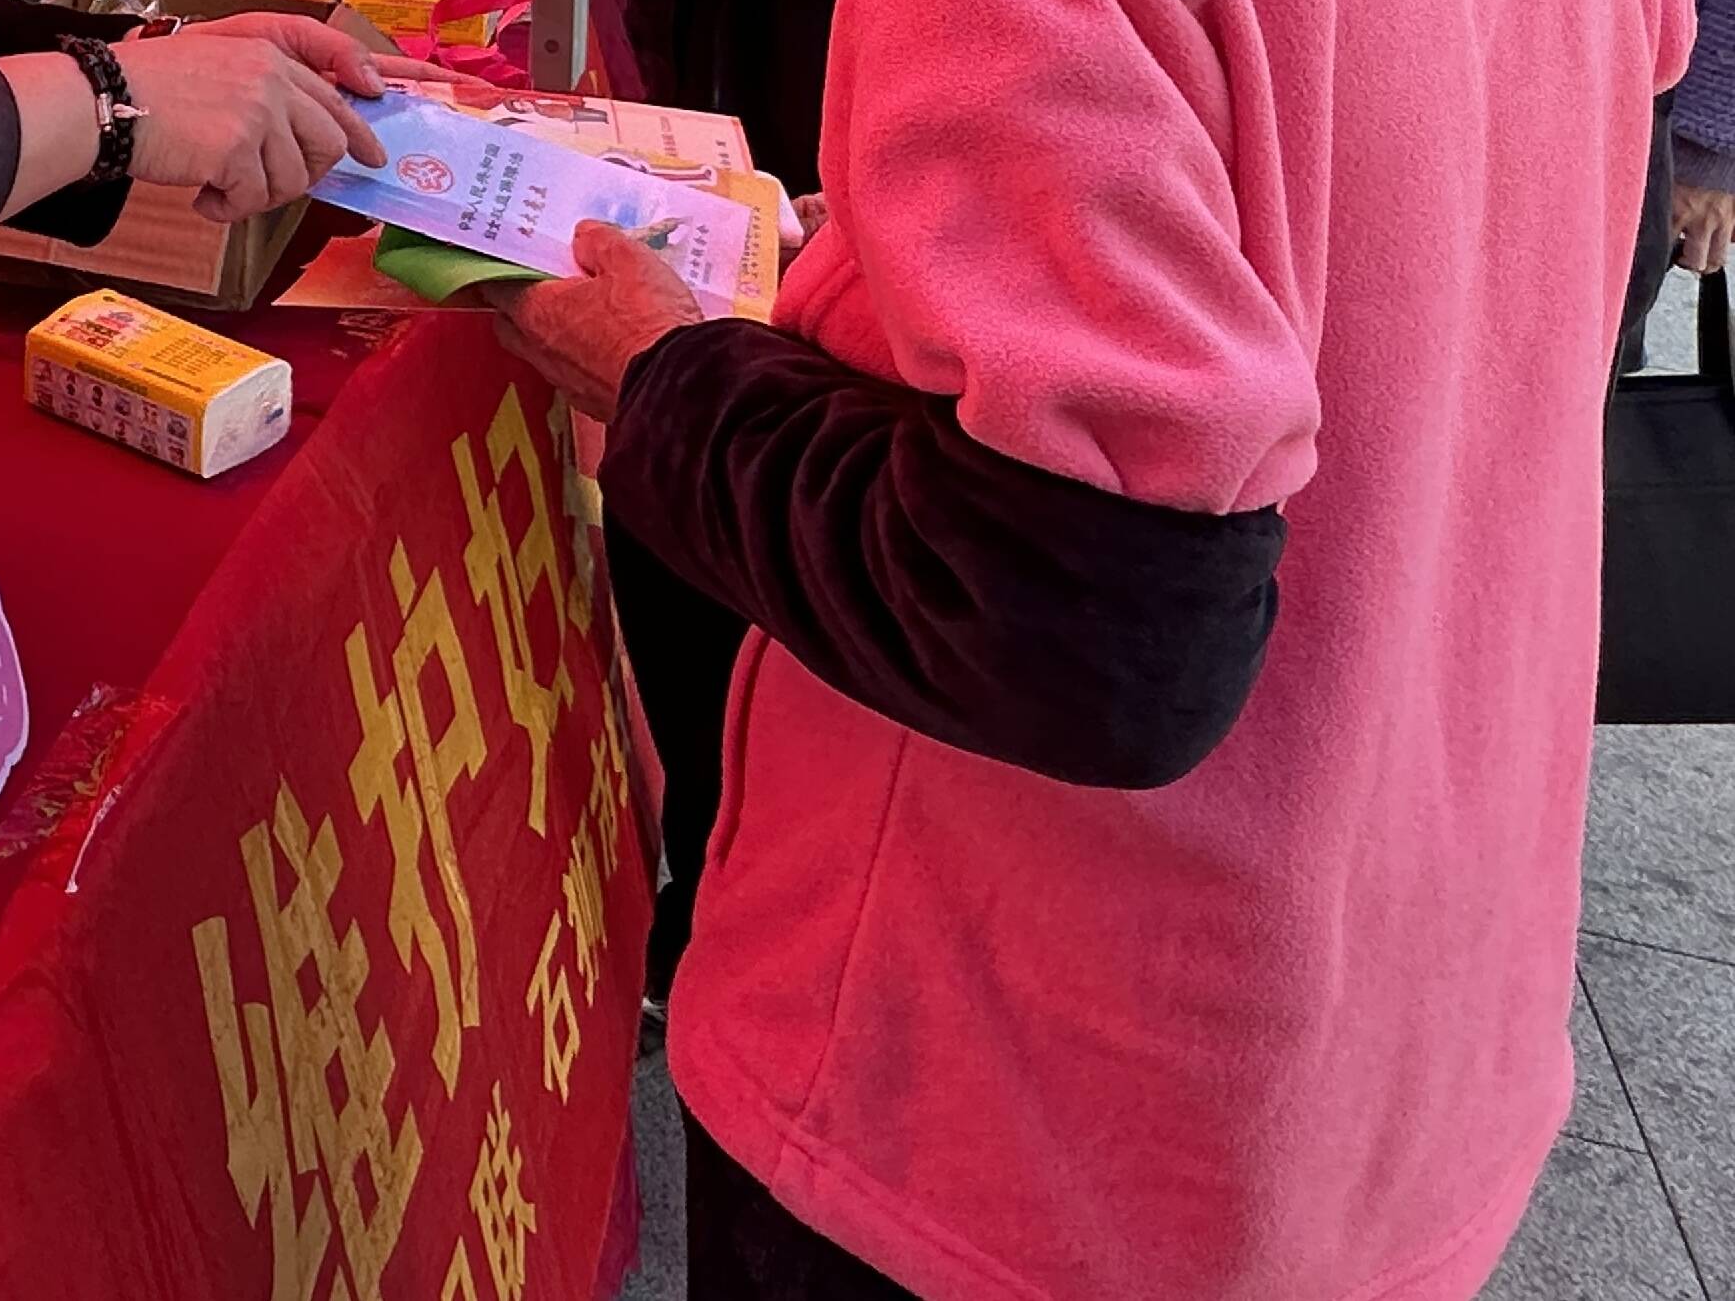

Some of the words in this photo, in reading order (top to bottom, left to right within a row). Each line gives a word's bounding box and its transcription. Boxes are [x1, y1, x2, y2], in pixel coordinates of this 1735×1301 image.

[458, 144, 500, 231] 中华人民共和国
